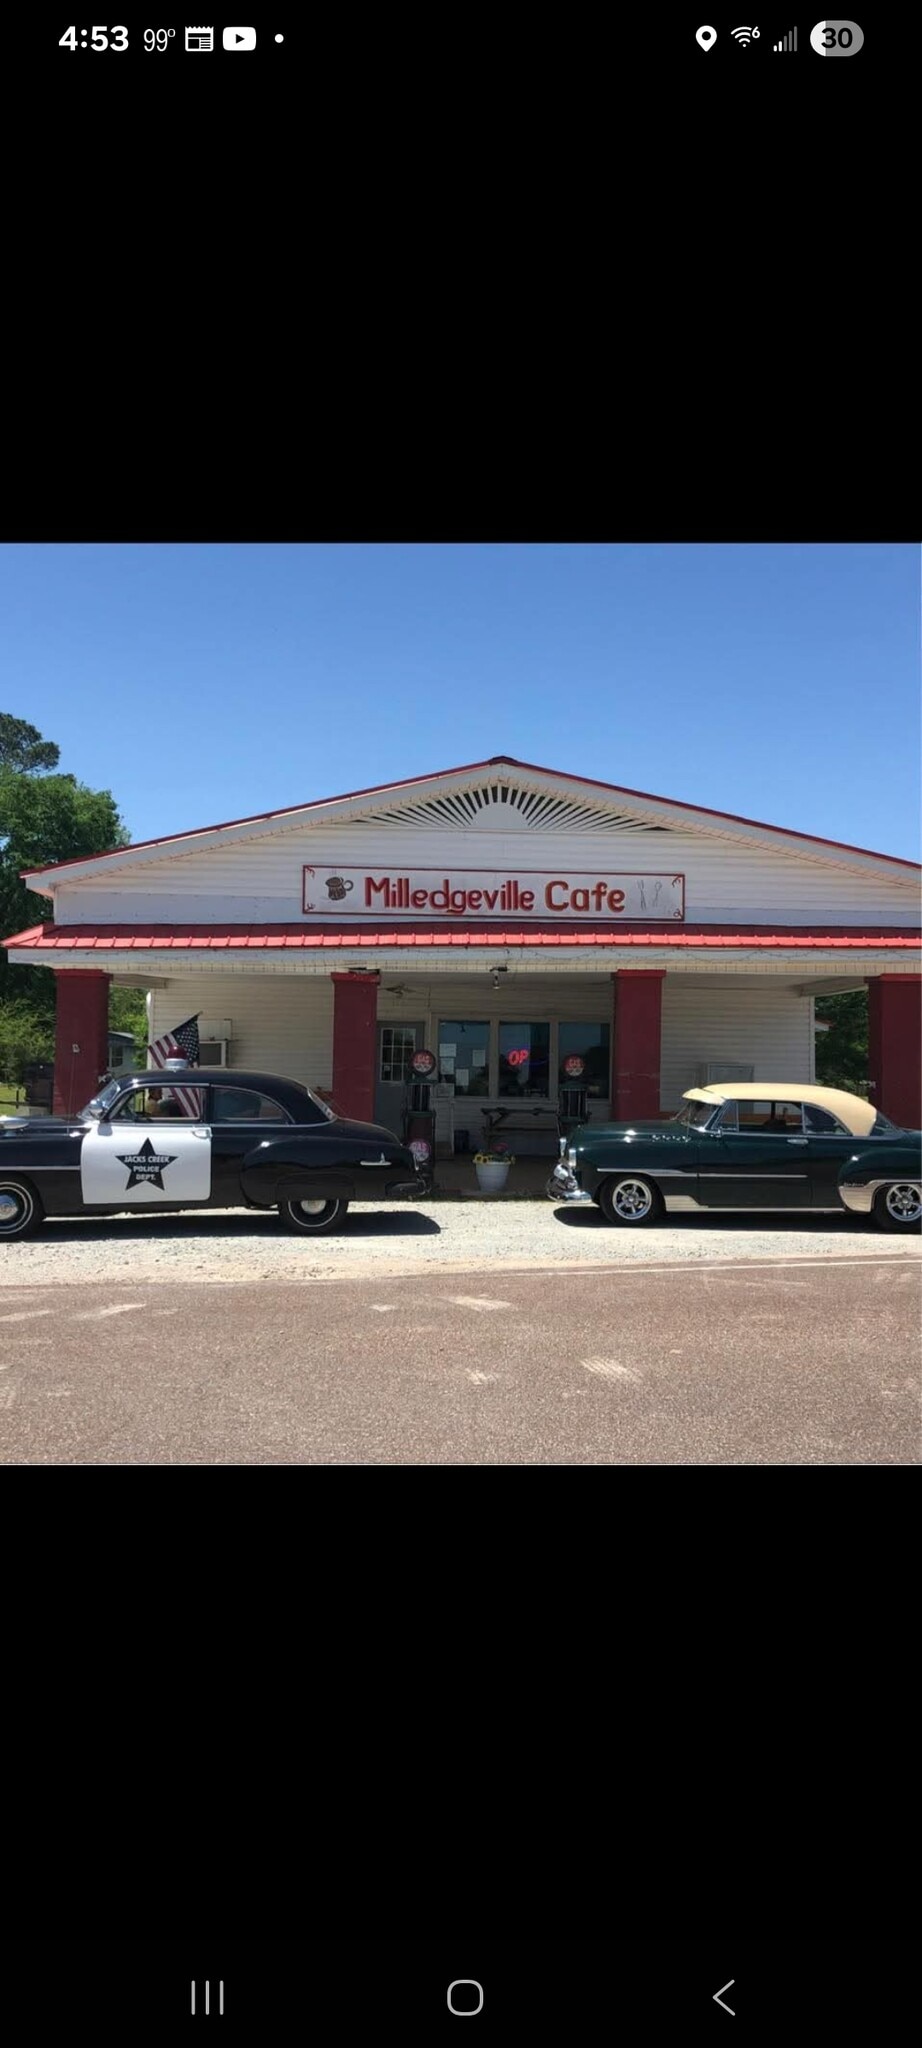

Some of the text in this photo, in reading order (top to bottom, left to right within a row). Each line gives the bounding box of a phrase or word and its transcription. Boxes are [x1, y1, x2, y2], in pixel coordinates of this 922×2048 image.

[364, 876, 626, 914] Milledgeville Cafe
[124, 1155, 170, 1163] JACKS CREEK
